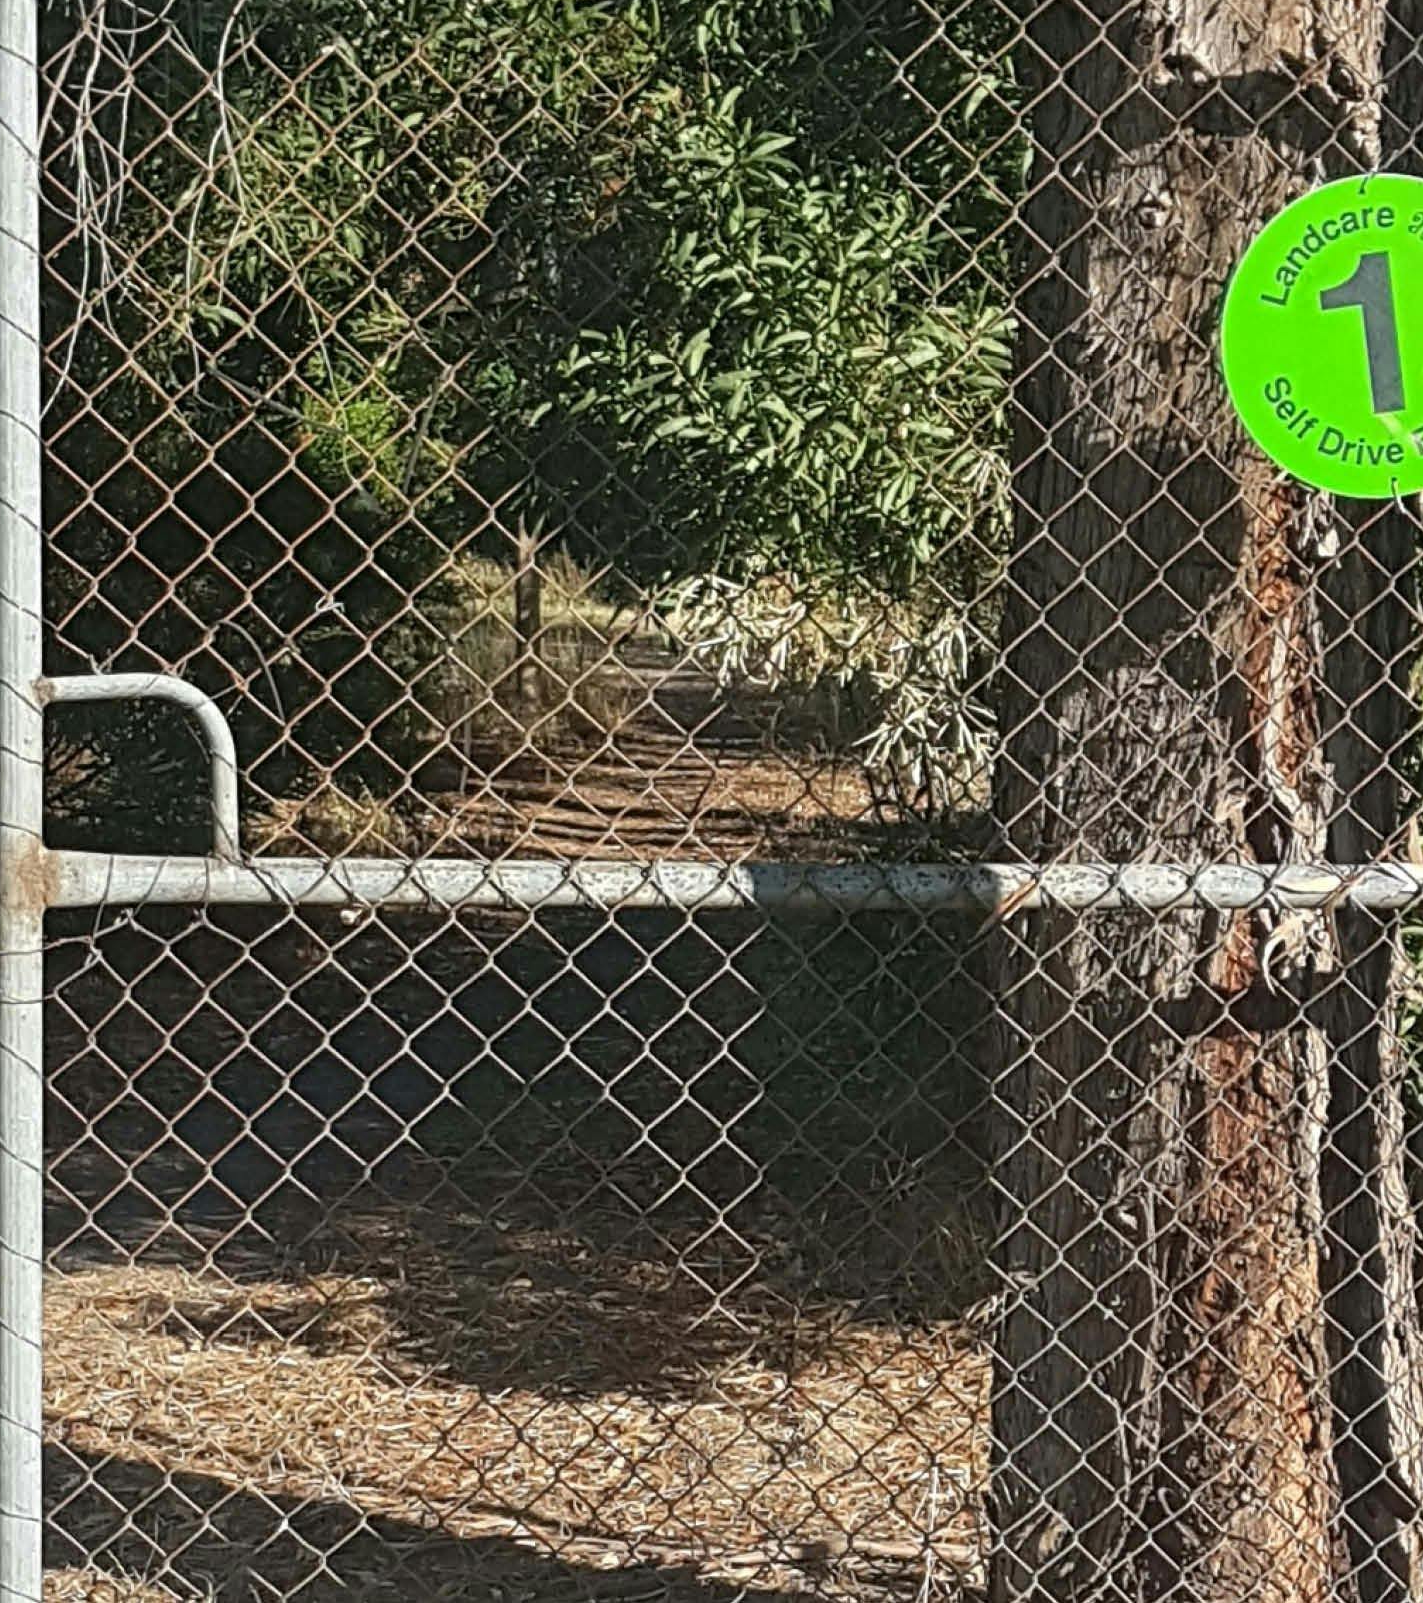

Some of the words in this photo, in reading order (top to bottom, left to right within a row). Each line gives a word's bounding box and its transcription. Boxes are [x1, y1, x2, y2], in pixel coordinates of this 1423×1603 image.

[1261, 206, 1395, 306] Landcare
[1320, 251, 1406, 414] 1
[1264, 377, 1319, 439] Self
[1318, 427, 1405, 465] Drive
